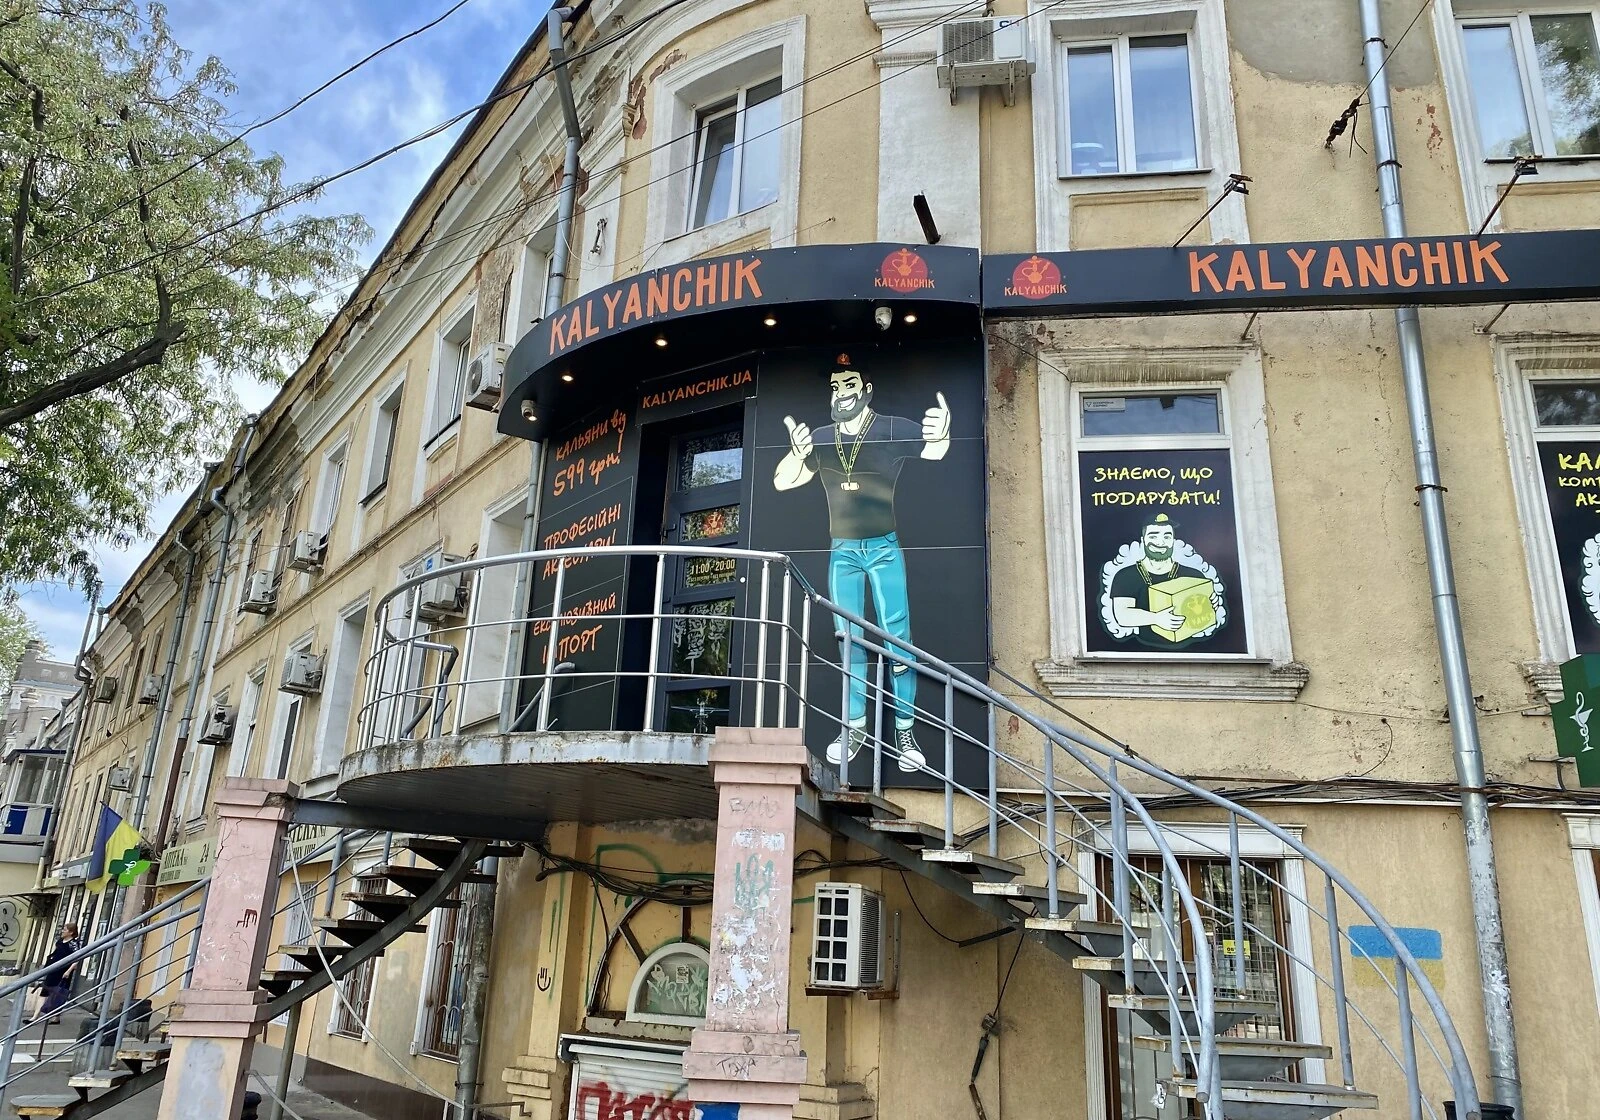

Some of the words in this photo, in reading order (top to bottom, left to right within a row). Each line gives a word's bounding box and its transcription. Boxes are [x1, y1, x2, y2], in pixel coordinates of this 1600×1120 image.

[1189, 240, 1510, 293] KALYANCHIK
[874, 277, 935, 289] KALYANCHIK
[1004, 284, 1067, 296] KALYANCHIK
[550, 258, 763, 355] KALYANCHIK
[642, 370, 752, 409] KALYANCHIK.UA
[556, 420, 608, 461] КАЛЬЯНИ
[1094, 467, 1176, 485] ЗНАЄМО,
[1180, 467, 1213, 485] ЩО
[1558, 452, 1600, 472] КА
[554, 458, 585, 496] 599
[1091, 489, 1220, 506] ПОДАРУВАТИ!
[544, 503, 621, 551] ПРОФЕСІЙНІ
[690, 562, 710, 575] 11:00
[715, 559, 736, 571] 20:00
